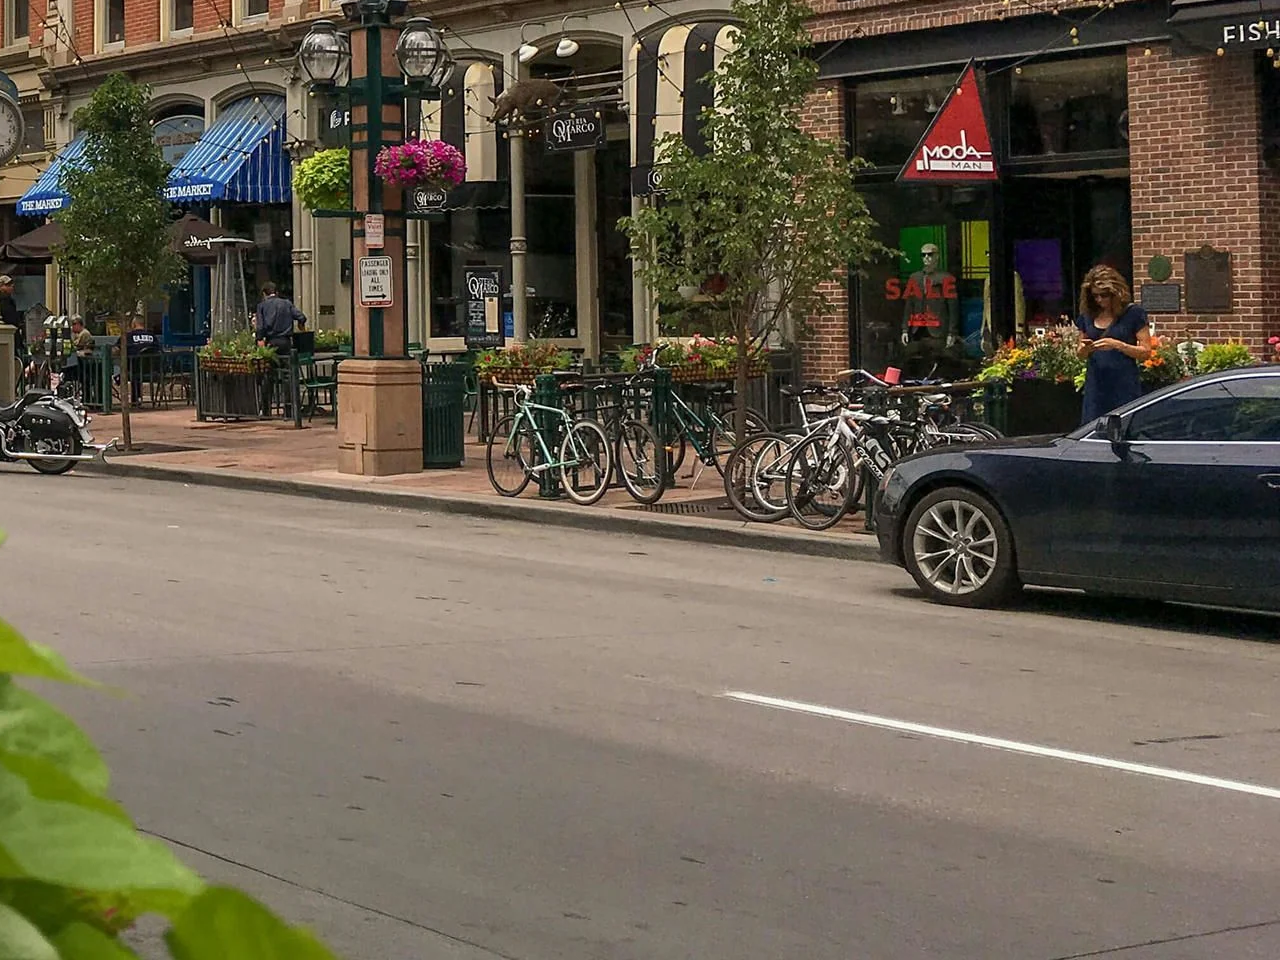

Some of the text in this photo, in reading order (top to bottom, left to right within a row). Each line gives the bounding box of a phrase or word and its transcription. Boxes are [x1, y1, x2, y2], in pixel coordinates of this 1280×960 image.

[1223, 20, 1280, 43] FISH
[951, 161, 982, 170] MAN
[178, 184, 213, 197] MARKET
[22, 200, 35, 211] THE
[361, 259, 389, 268] PASSENGER
[885, 275, 957, 300] SALE
